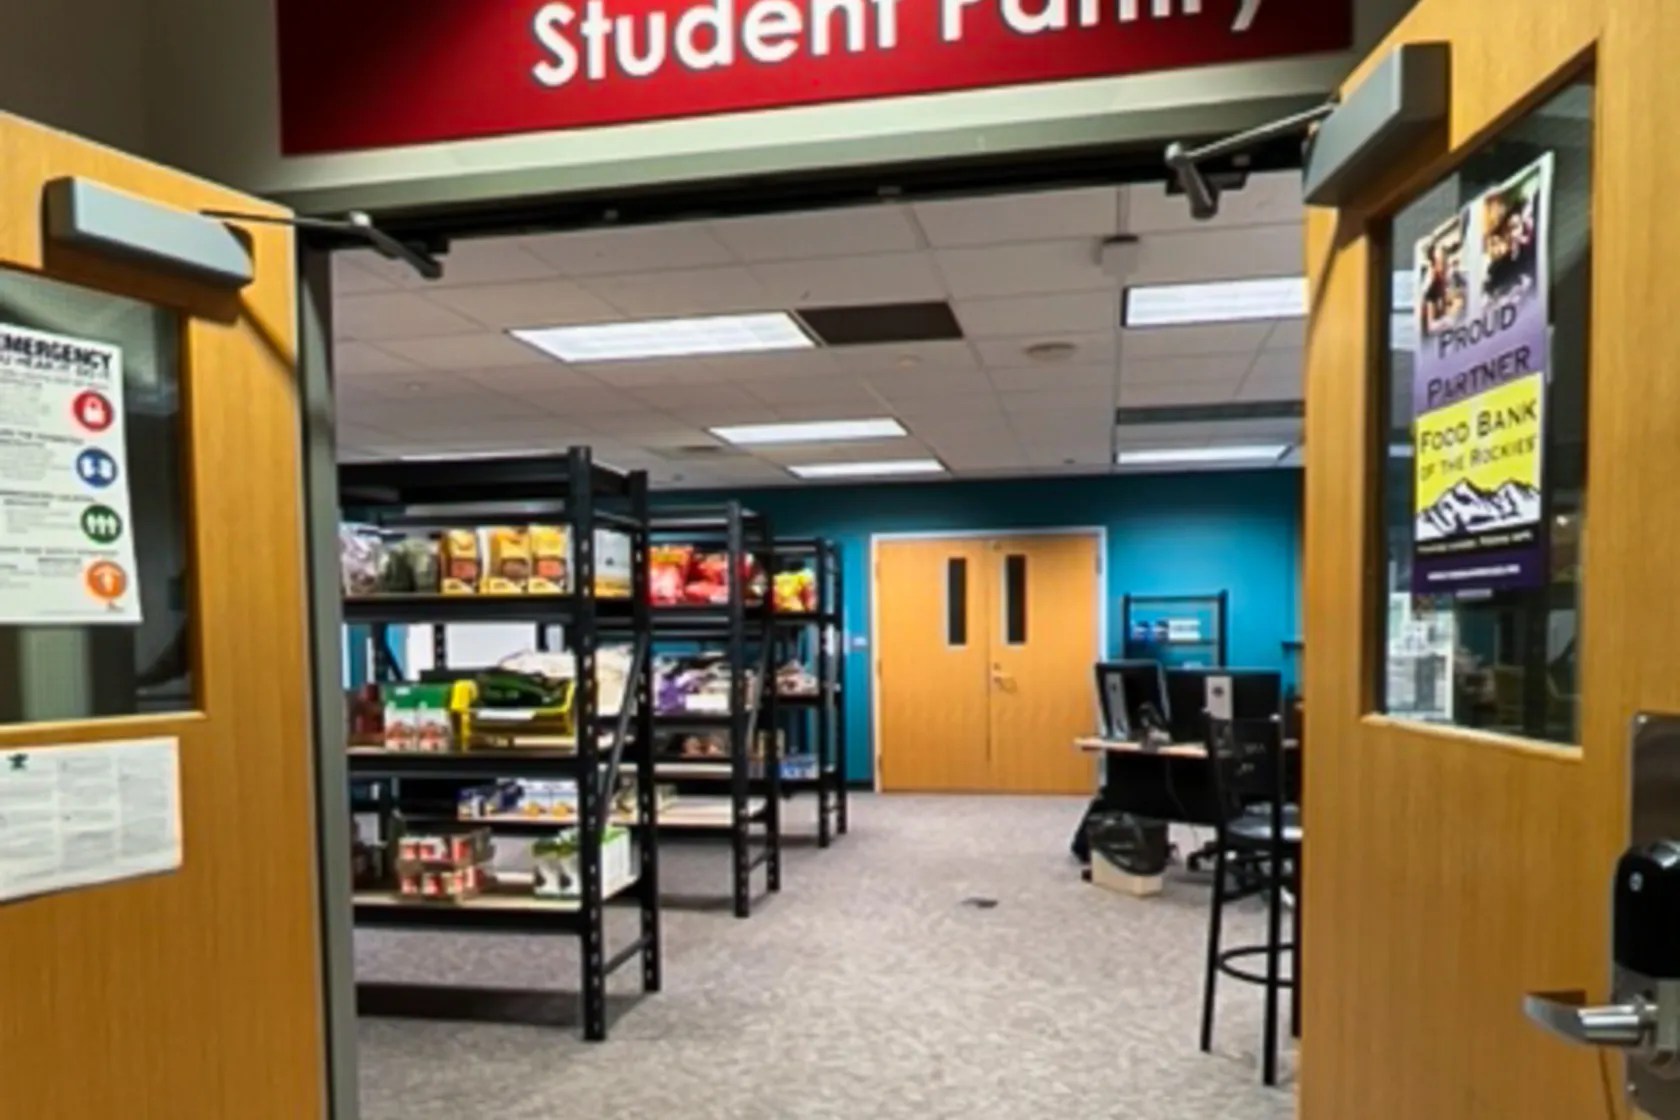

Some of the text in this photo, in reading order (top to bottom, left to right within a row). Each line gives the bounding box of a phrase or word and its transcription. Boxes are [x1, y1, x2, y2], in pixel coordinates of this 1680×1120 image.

[532, 0, 896, 87] Student
[0, 333, 112, 370] MERGENCY
[1438, 302, 1517, 359] PROUD
[1427, 345, 1531, 407] PARTNER
[1420, 397, 1537, 454] FOOD BANK
